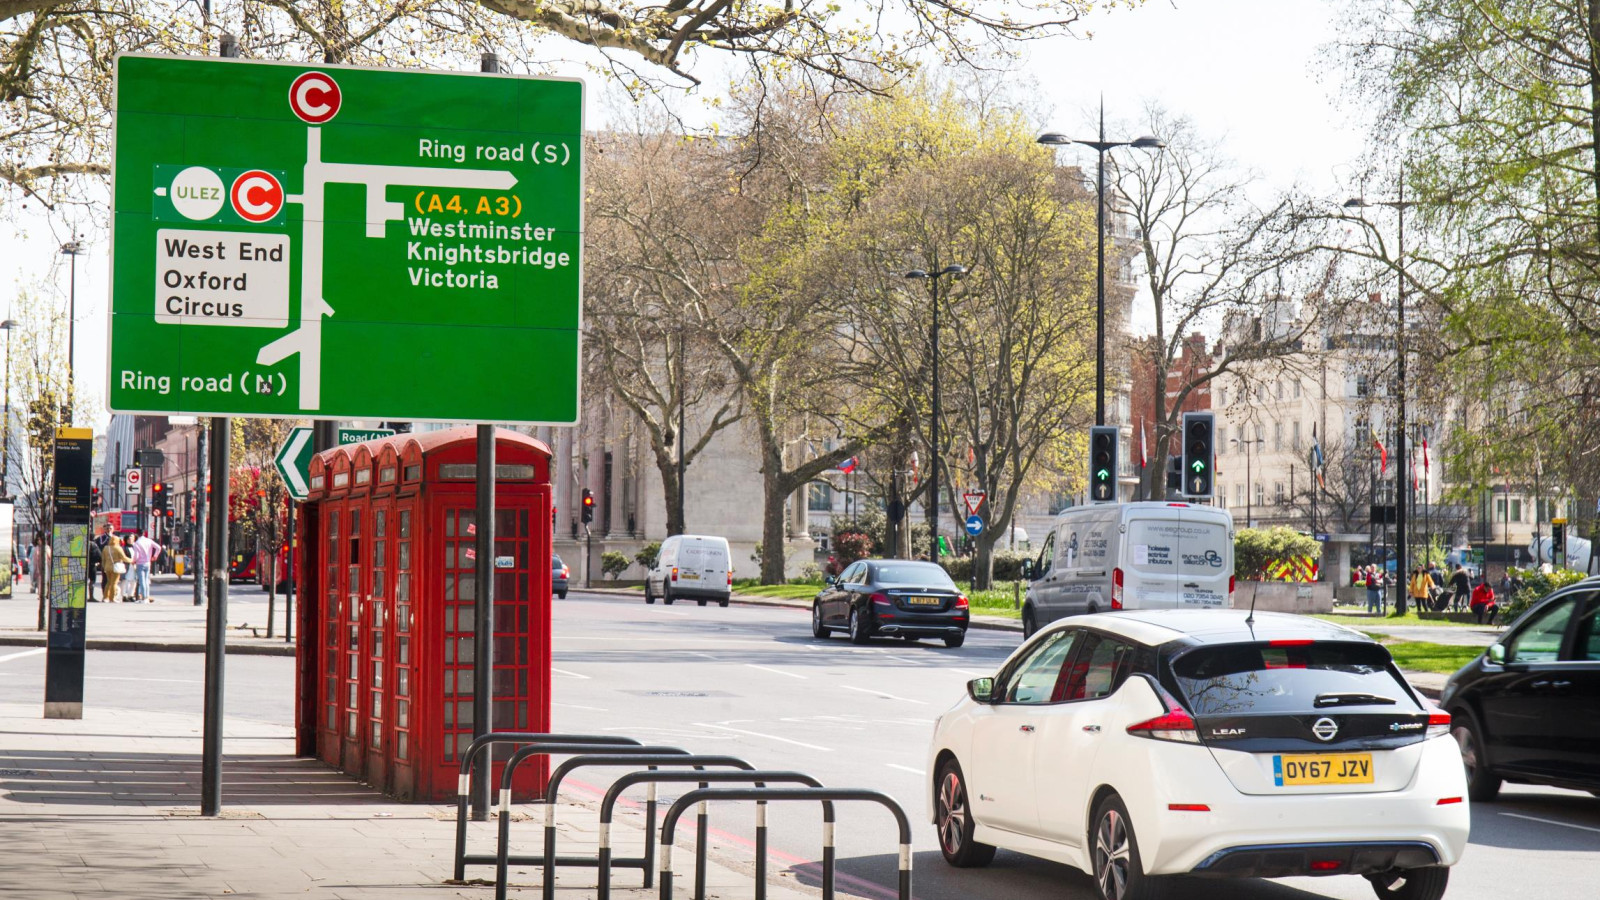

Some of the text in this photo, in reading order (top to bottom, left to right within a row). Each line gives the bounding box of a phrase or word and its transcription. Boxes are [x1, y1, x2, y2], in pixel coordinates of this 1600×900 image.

[419, 139, 570, 166] Ring road (S)
[176, 186, 220, 201] ULEZ
[414, 190, 522, 218] (A4, A3)
[407, 217, 556, 241] Westminster
[164, 238, 283, 262] West End
[407, 241, 570, 270] Knightsbridge
[163, 269, 247, 291] Oxford
[407, 267, 499, 289] Victoria
[165, 295, 244, 317] Circus
[121, 370, 171, 395] Ring
[181, 373, 233, 393] road
[341, 432, 368, 442] Road
[1286, 760, 1369, 779] OY67 JZV
